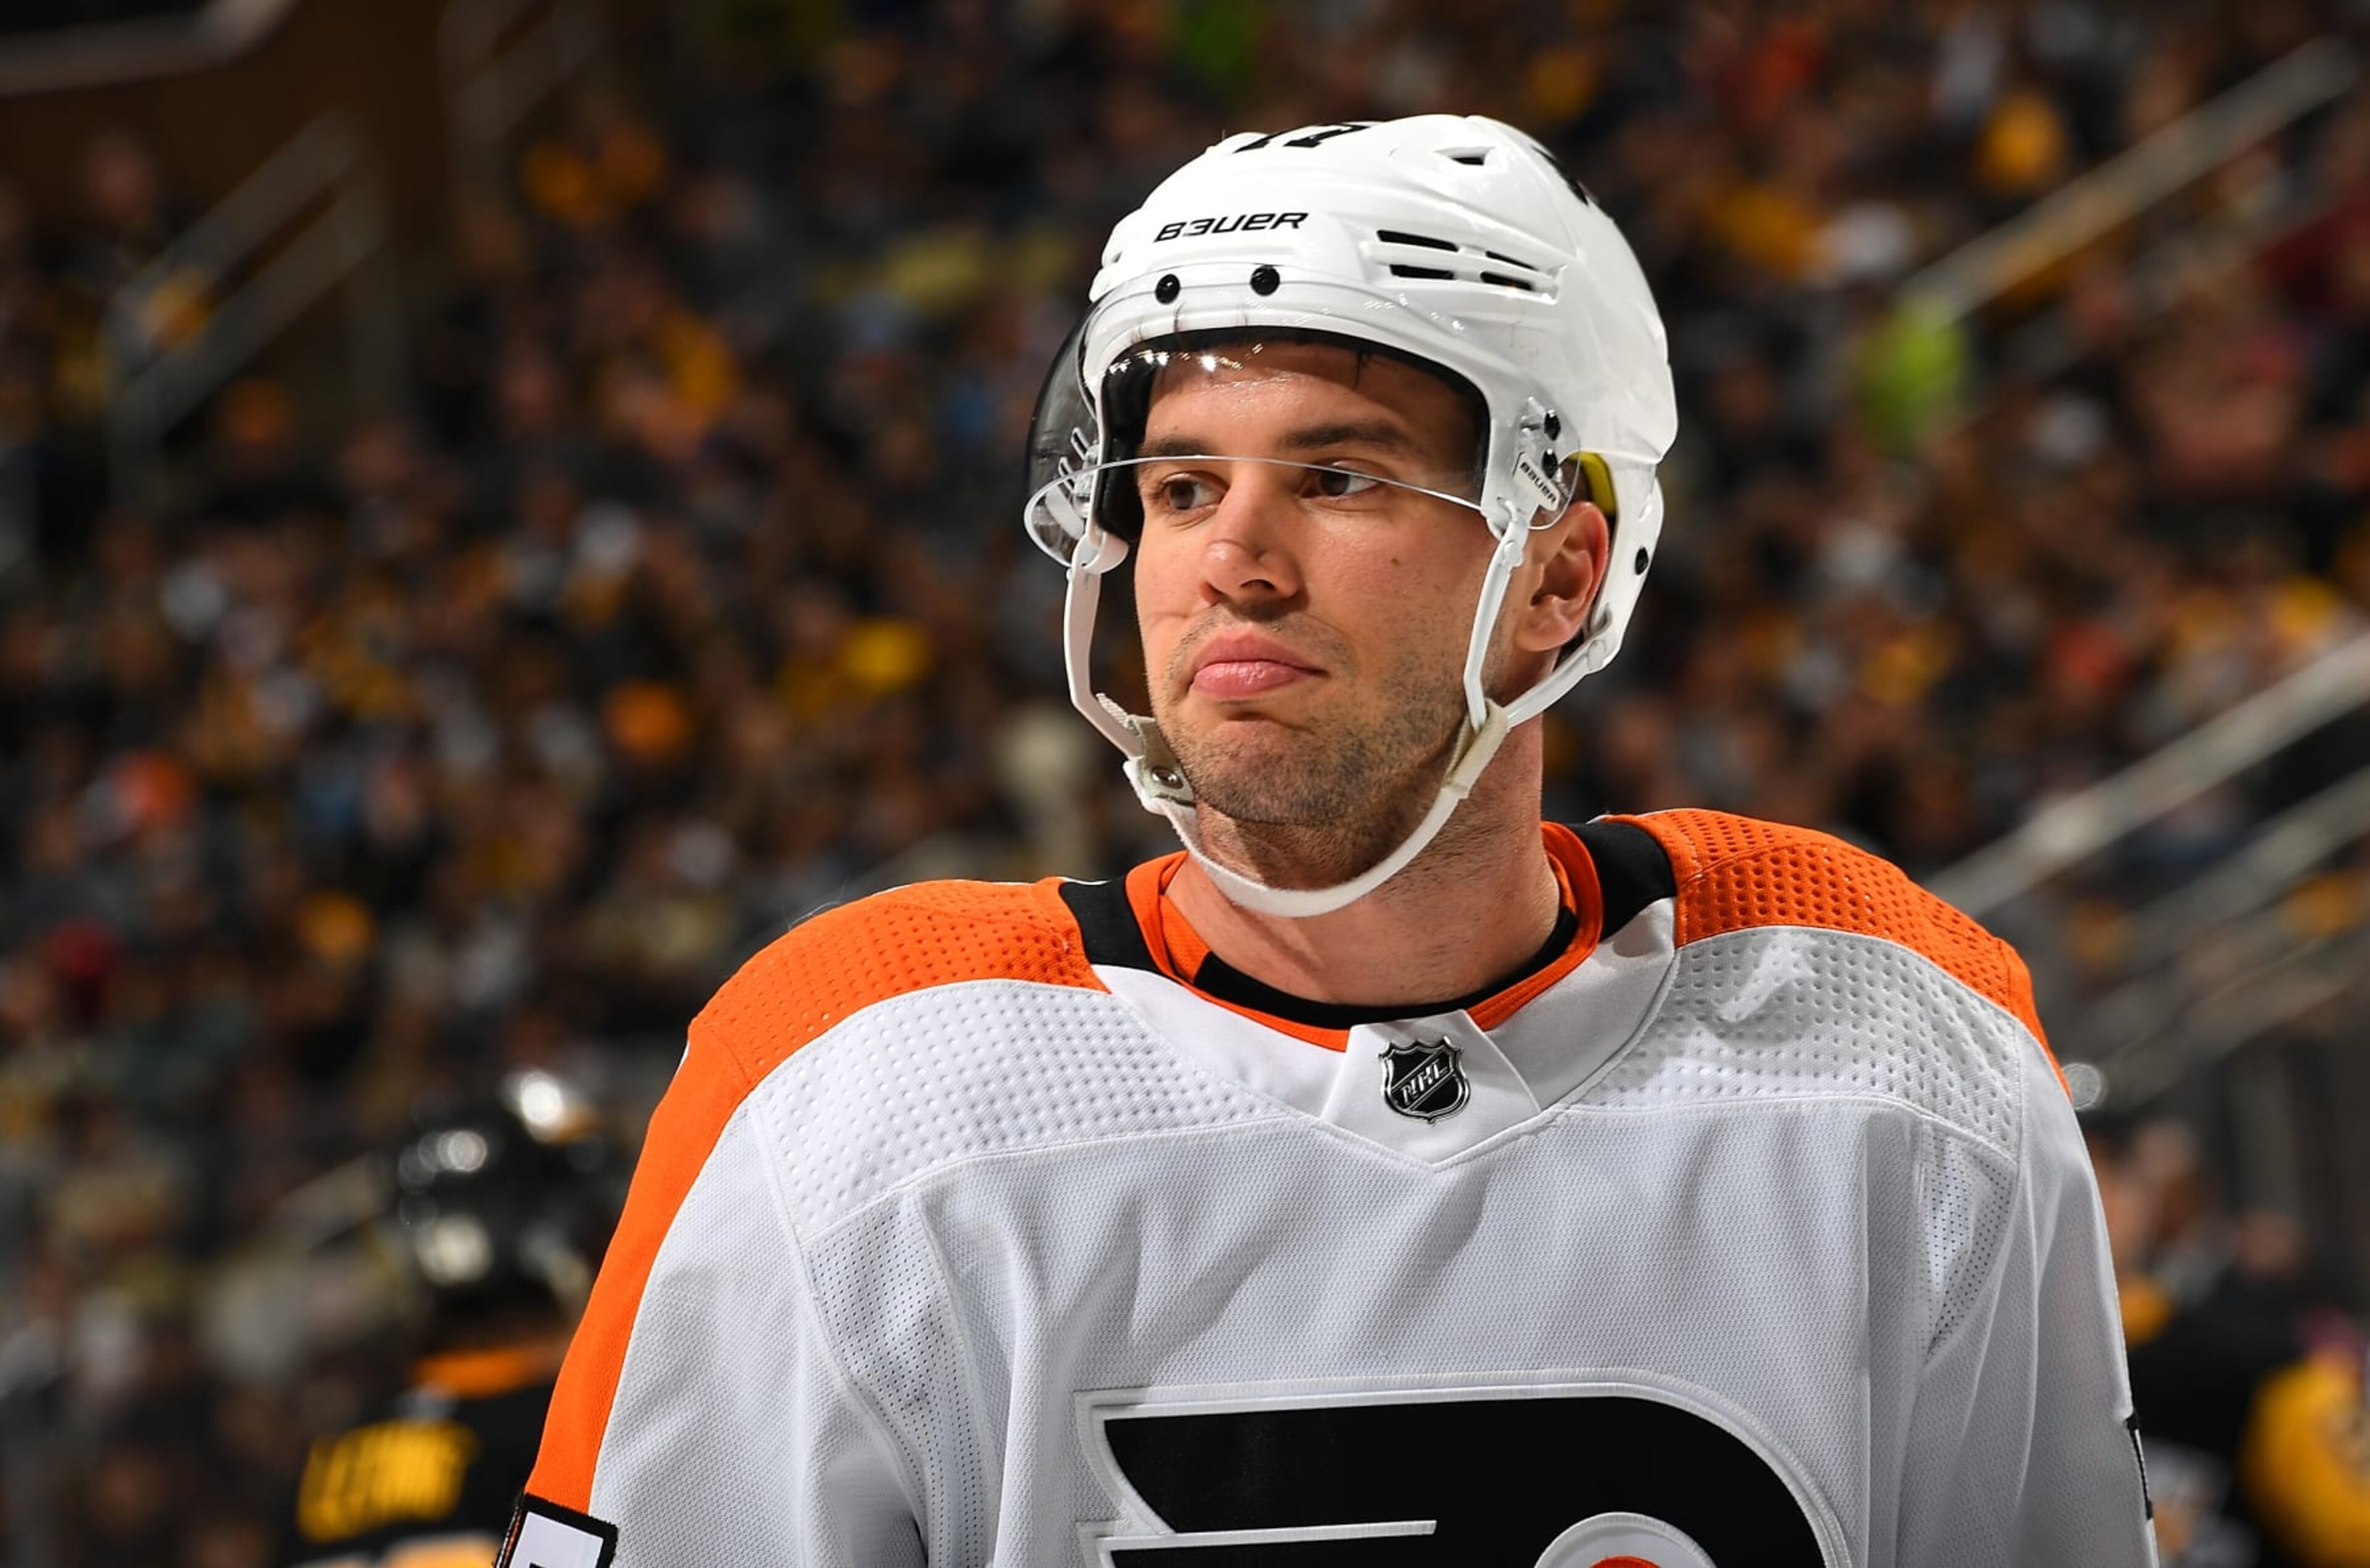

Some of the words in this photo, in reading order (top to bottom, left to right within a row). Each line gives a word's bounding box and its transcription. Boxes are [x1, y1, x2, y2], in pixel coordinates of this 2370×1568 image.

[1153, 212, 1308, 243] BAUER
[1520, 462, 1557, 505] BAUER
[1400, 1060, 1449, 1106] NHL
